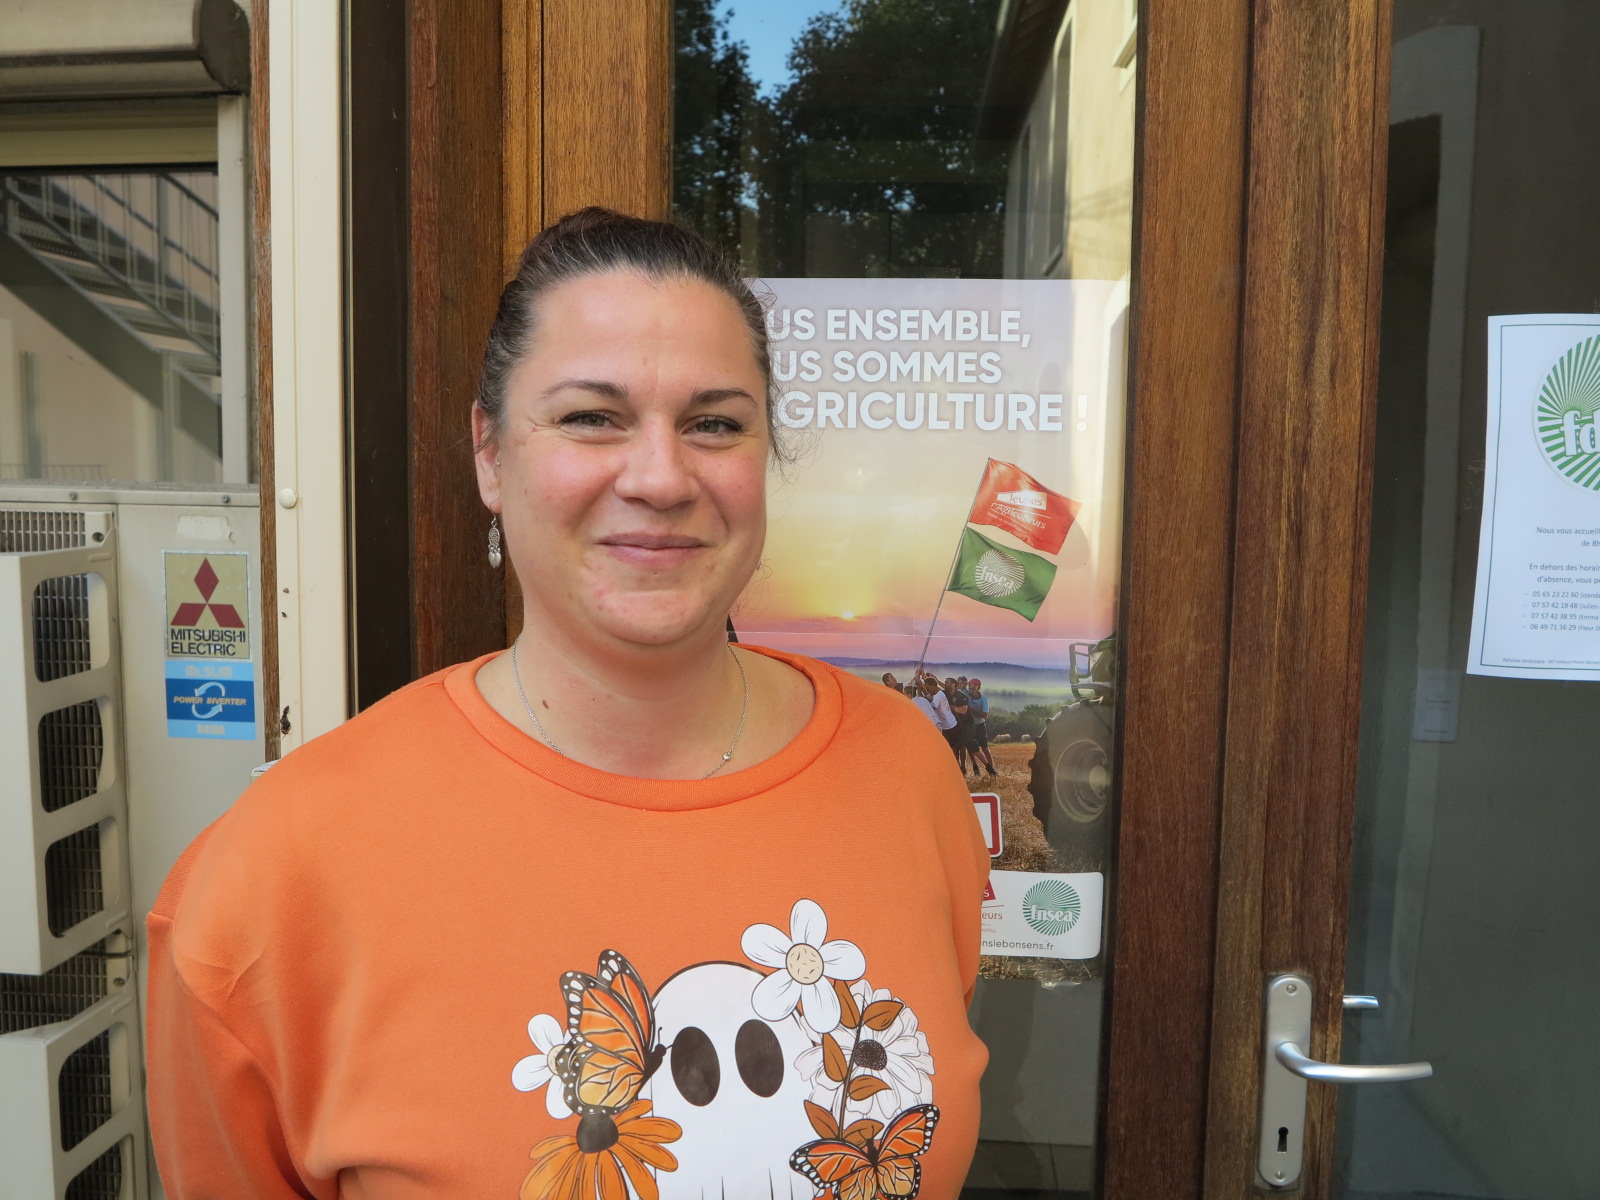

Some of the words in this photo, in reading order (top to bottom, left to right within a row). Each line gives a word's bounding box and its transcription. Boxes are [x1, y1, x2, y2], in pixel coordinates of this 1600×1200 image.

[766, 308, 816, 341] US
[827, 308, 1031, 347] ENSEMBLE,
[773, 350, 823, 382] US
[832, 350, 1002, 383] SOMMES
[1076, 394, 1088, 431] !
[1540, 563, 1564, 571] dehors
[1537, 576, 1574, 584] d'absence,
[170, 628, 246, 643] MITSUBISHI
[171, 642, 236, 656] ELECTRIC
[173, 696, 204, 705] POWER
[206, 697, 247, 706] INVERTER
[1030, 904, 1073, 922] fnsea
[981, 939, 1054, 951] nslebonsens.fr
